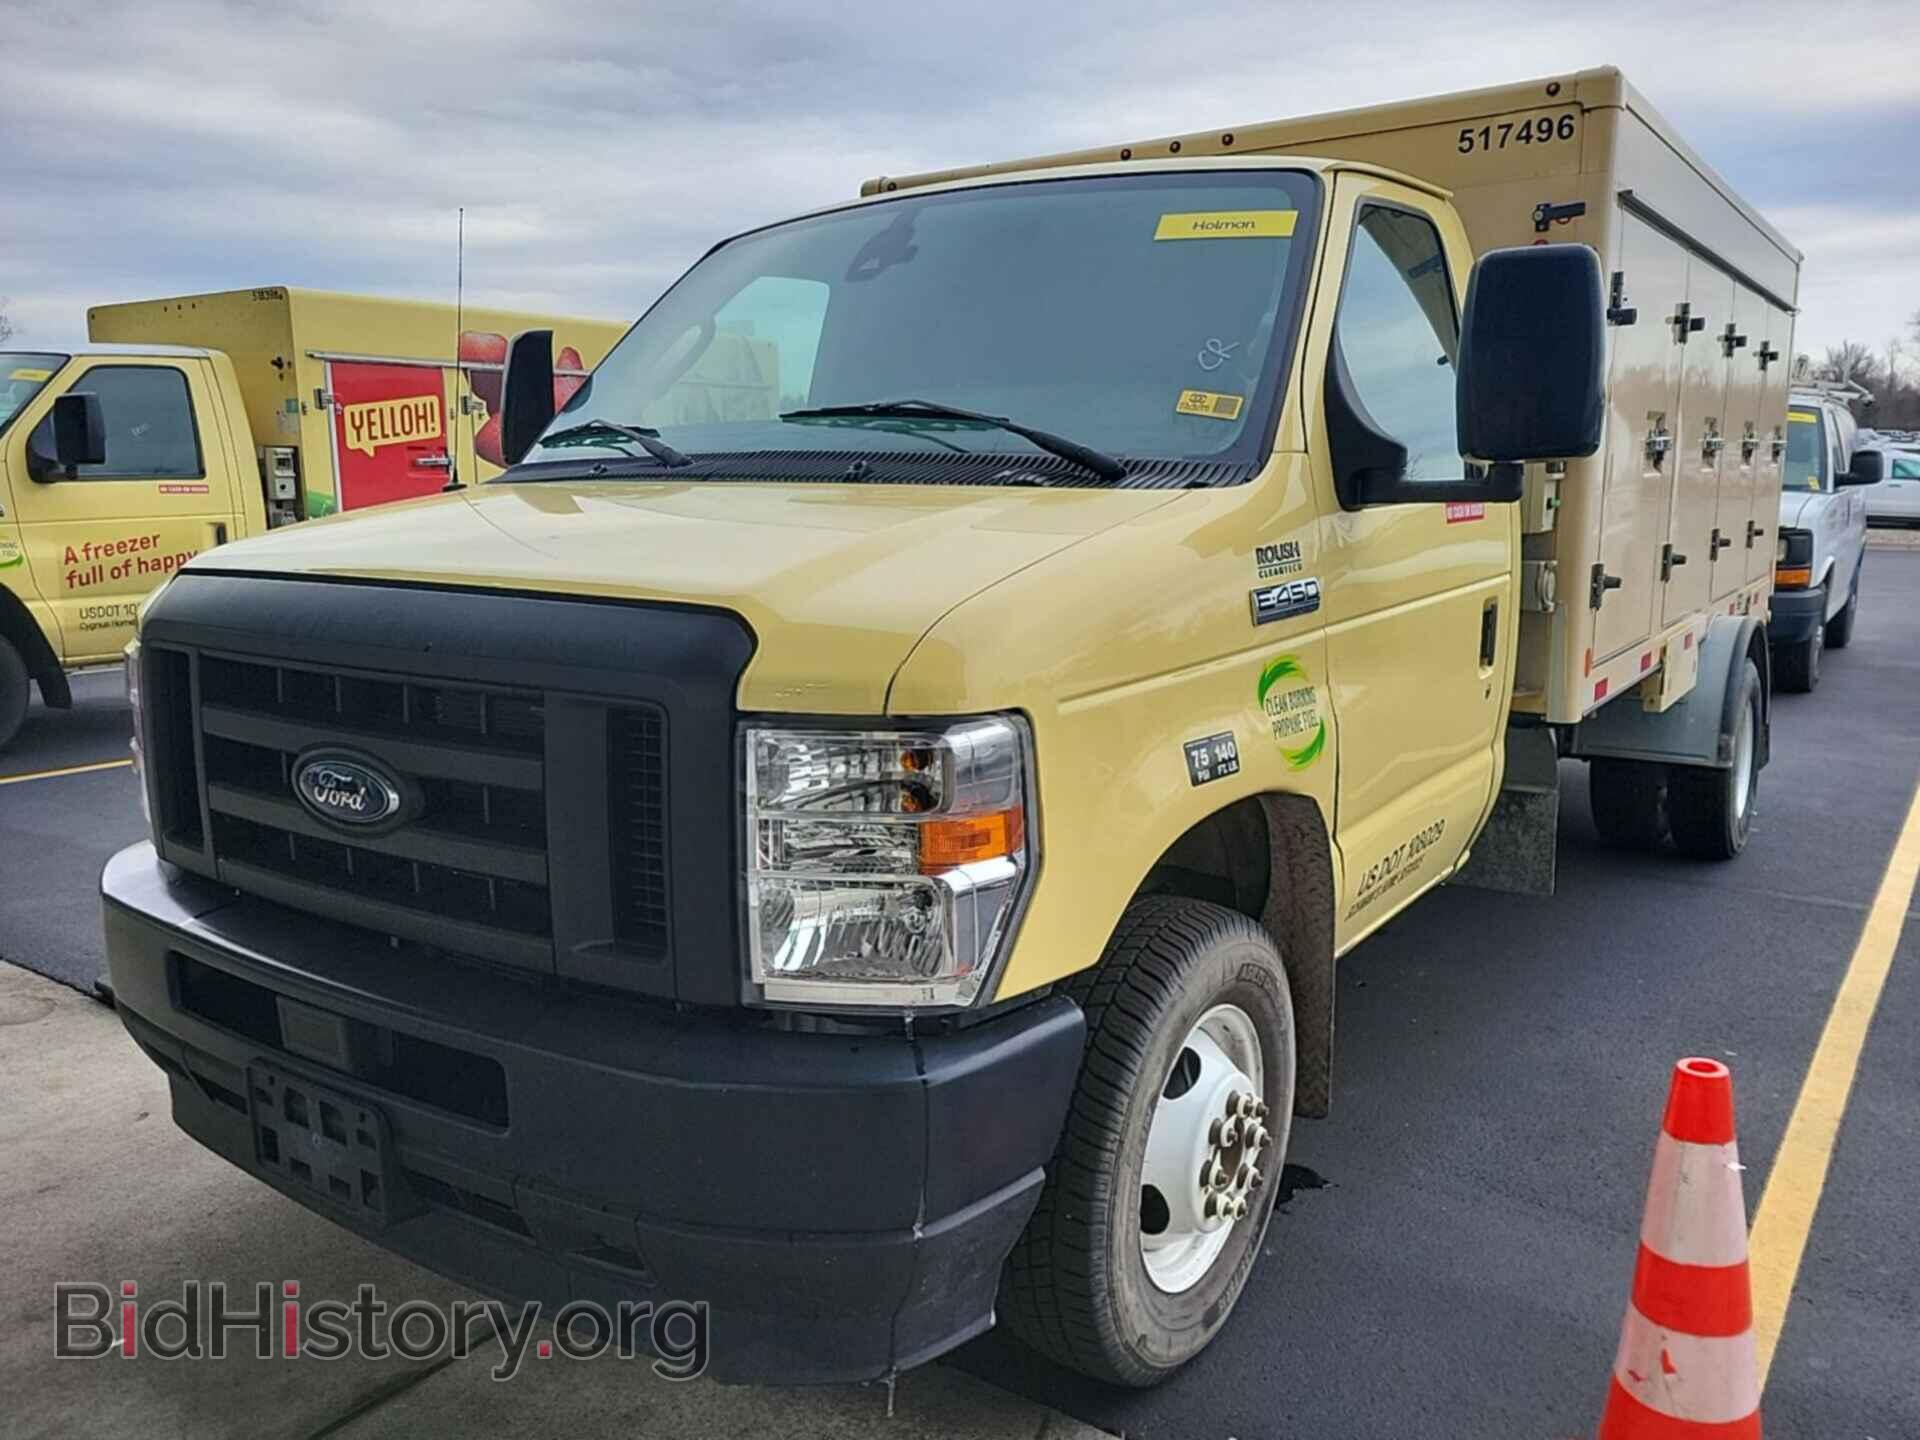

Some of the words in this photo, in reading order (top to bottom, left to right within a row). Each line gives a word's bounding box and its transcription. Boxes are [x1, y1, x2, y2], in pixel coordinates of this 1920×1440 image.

[1458, 114, 1575, 153] 517496
[1192, 220, 1256, 231] Holman
[350, 402, 436, 442] YELLOH!
[64, 546, 79, 565] A
[82, 534, 161, 561] freezer
[1255, 541, 1301, 565] ROUSH
[66, 564, 104, 589] full
[110, 559, 132, 580] of
[79, 605, 120, 620] USDOT
[1265, 693, 1288, 717] CLEAN
[1190, 748, 1210, 769] 75
[1214, 741, 1236, 762] 140
[314, 770, 367, 811] Ford
